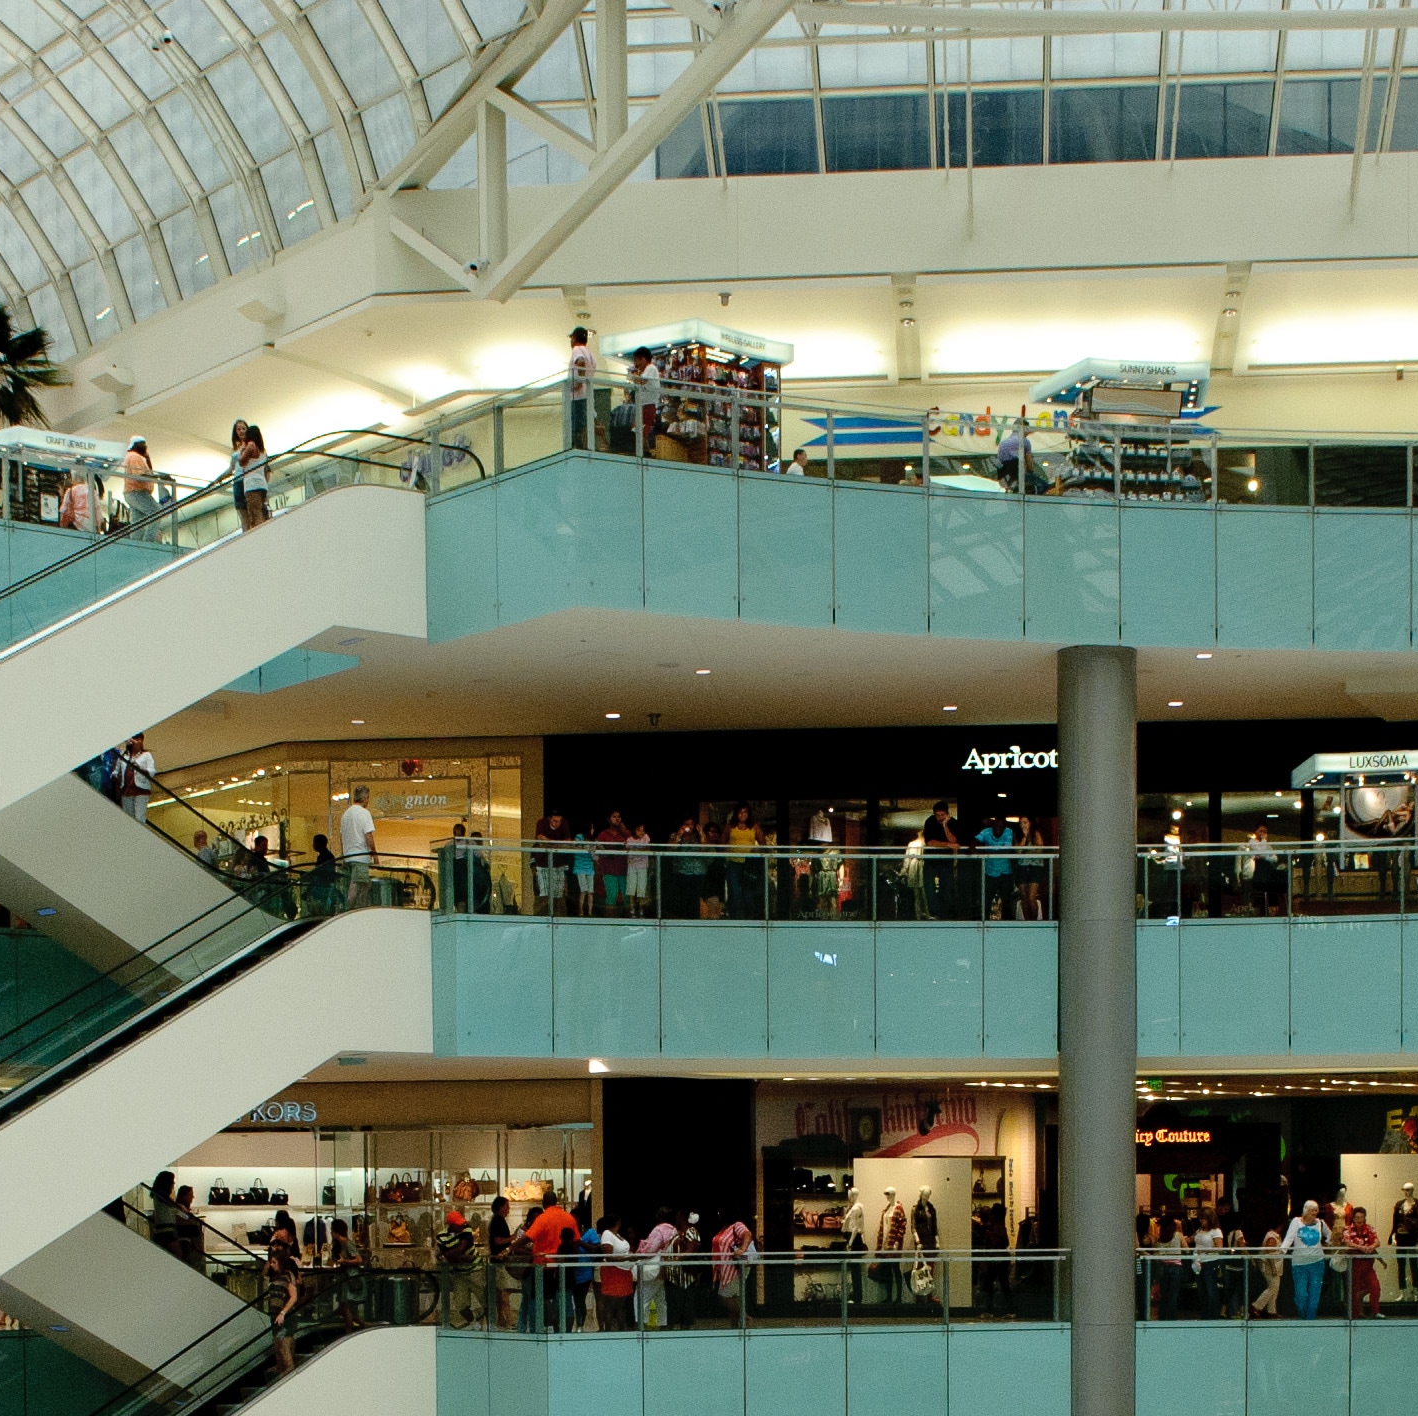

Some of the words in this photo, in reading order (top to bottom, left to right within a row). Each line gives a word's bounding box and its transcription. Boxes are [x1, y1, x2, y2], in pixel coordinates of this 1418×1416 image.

[1119, 364, 1146, 373] SUNNY
[1147, 366, 1177, 375] SHADES
[45, 436, 66, 446] CRAFT
[67, 439, 97, 451] JEWELRY
[962, 745, 1058, 775] Apricot
[1349, 754, 1409, 769] LUXSOMA
[250, 1101, 318, 1123] KORS
[1135, 1129, 1153, 1147] icy
[1155, 1128, 1211, 1143] Couture
